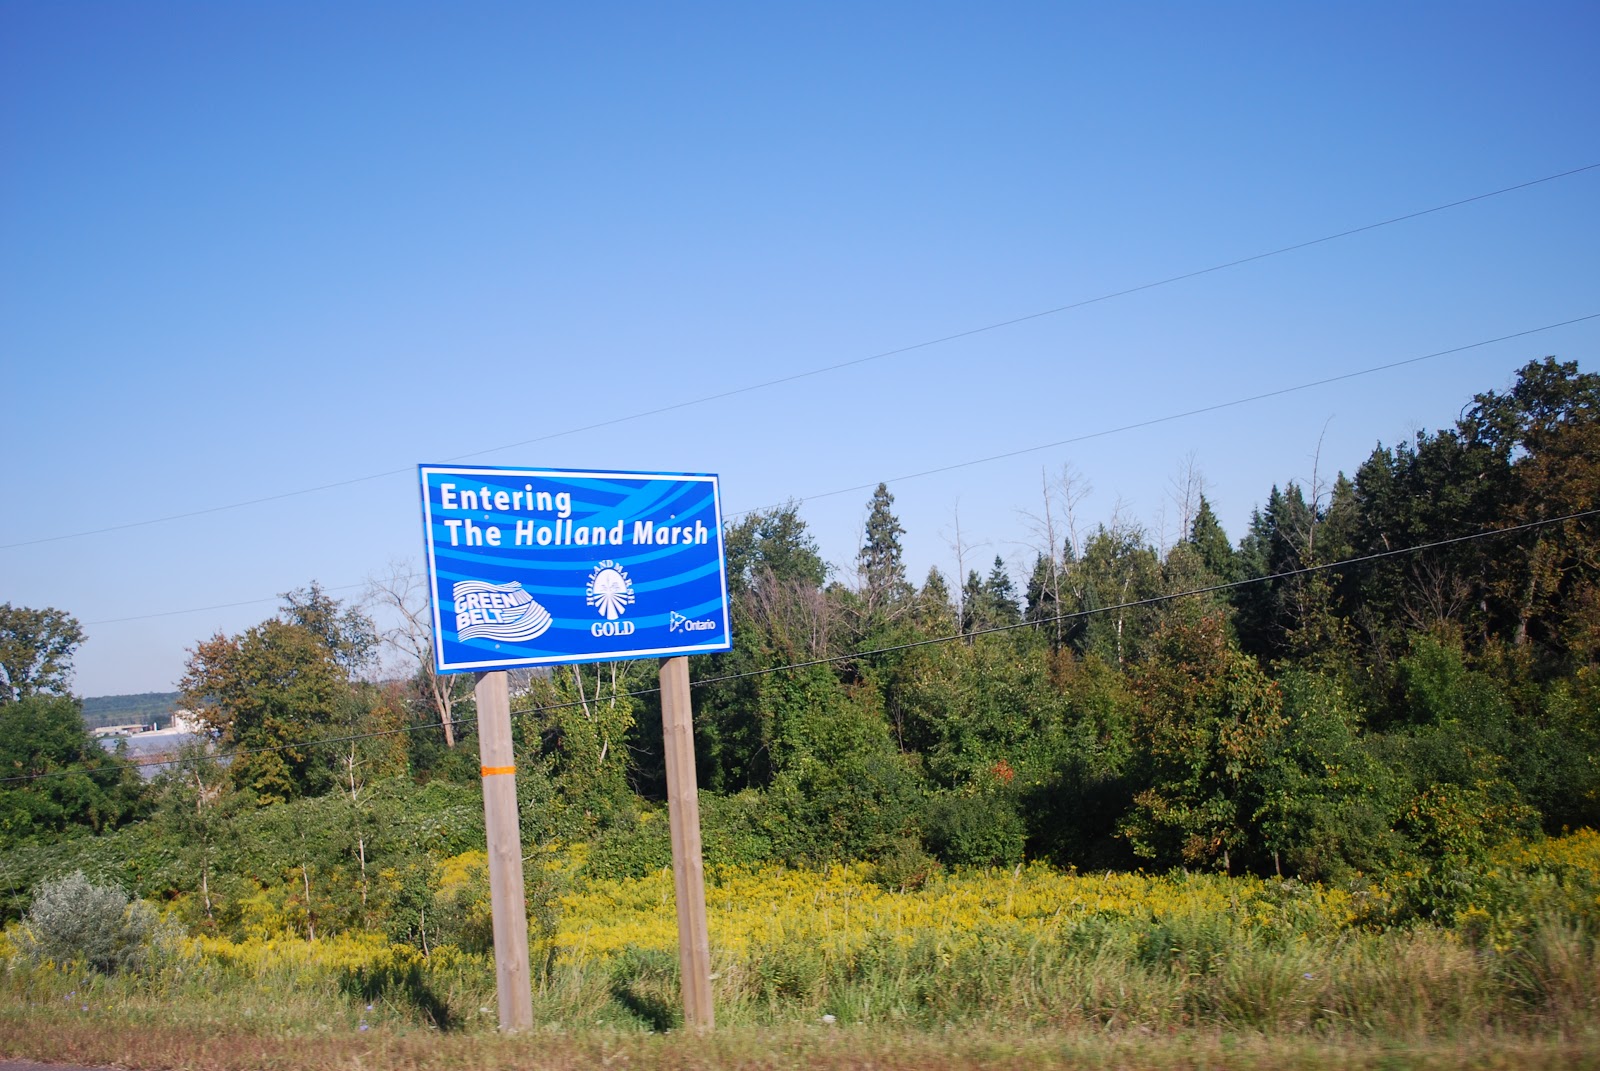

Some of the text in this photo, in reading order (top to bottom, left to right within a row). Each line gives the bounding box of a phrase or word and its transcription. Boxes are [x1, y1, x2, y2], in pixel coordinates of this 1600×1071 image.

[440, 483, 572, 518] Entering
[444, 519, 708, 547] The Holland Marsh
[586, 559, 636, 606] HOLLAND MARSH
[454, 592, 518, 614] GREEN
[456, 608, 506, 631] BELT
[591, 620, 635, 637] GOLD
[684, 619, 716, 632] Ontario
